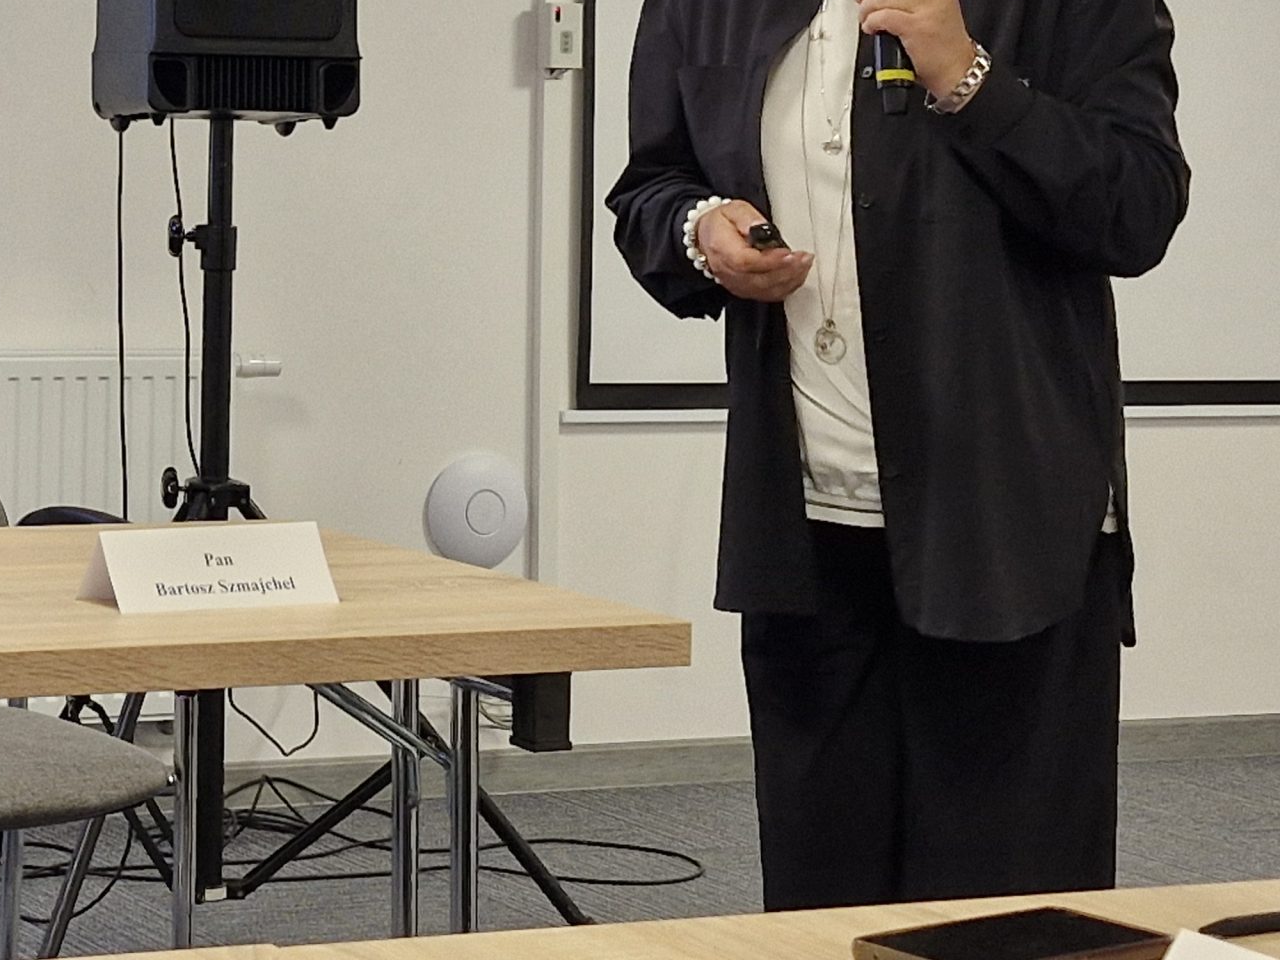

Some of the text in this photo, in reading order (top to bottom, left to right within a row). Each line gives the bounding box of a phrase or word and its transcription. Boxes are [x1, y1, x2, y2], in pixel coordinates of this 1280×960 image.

[204, 553, 234, 567] Pan
[155, 576, 296, 597] Bartosz Szmajchel
